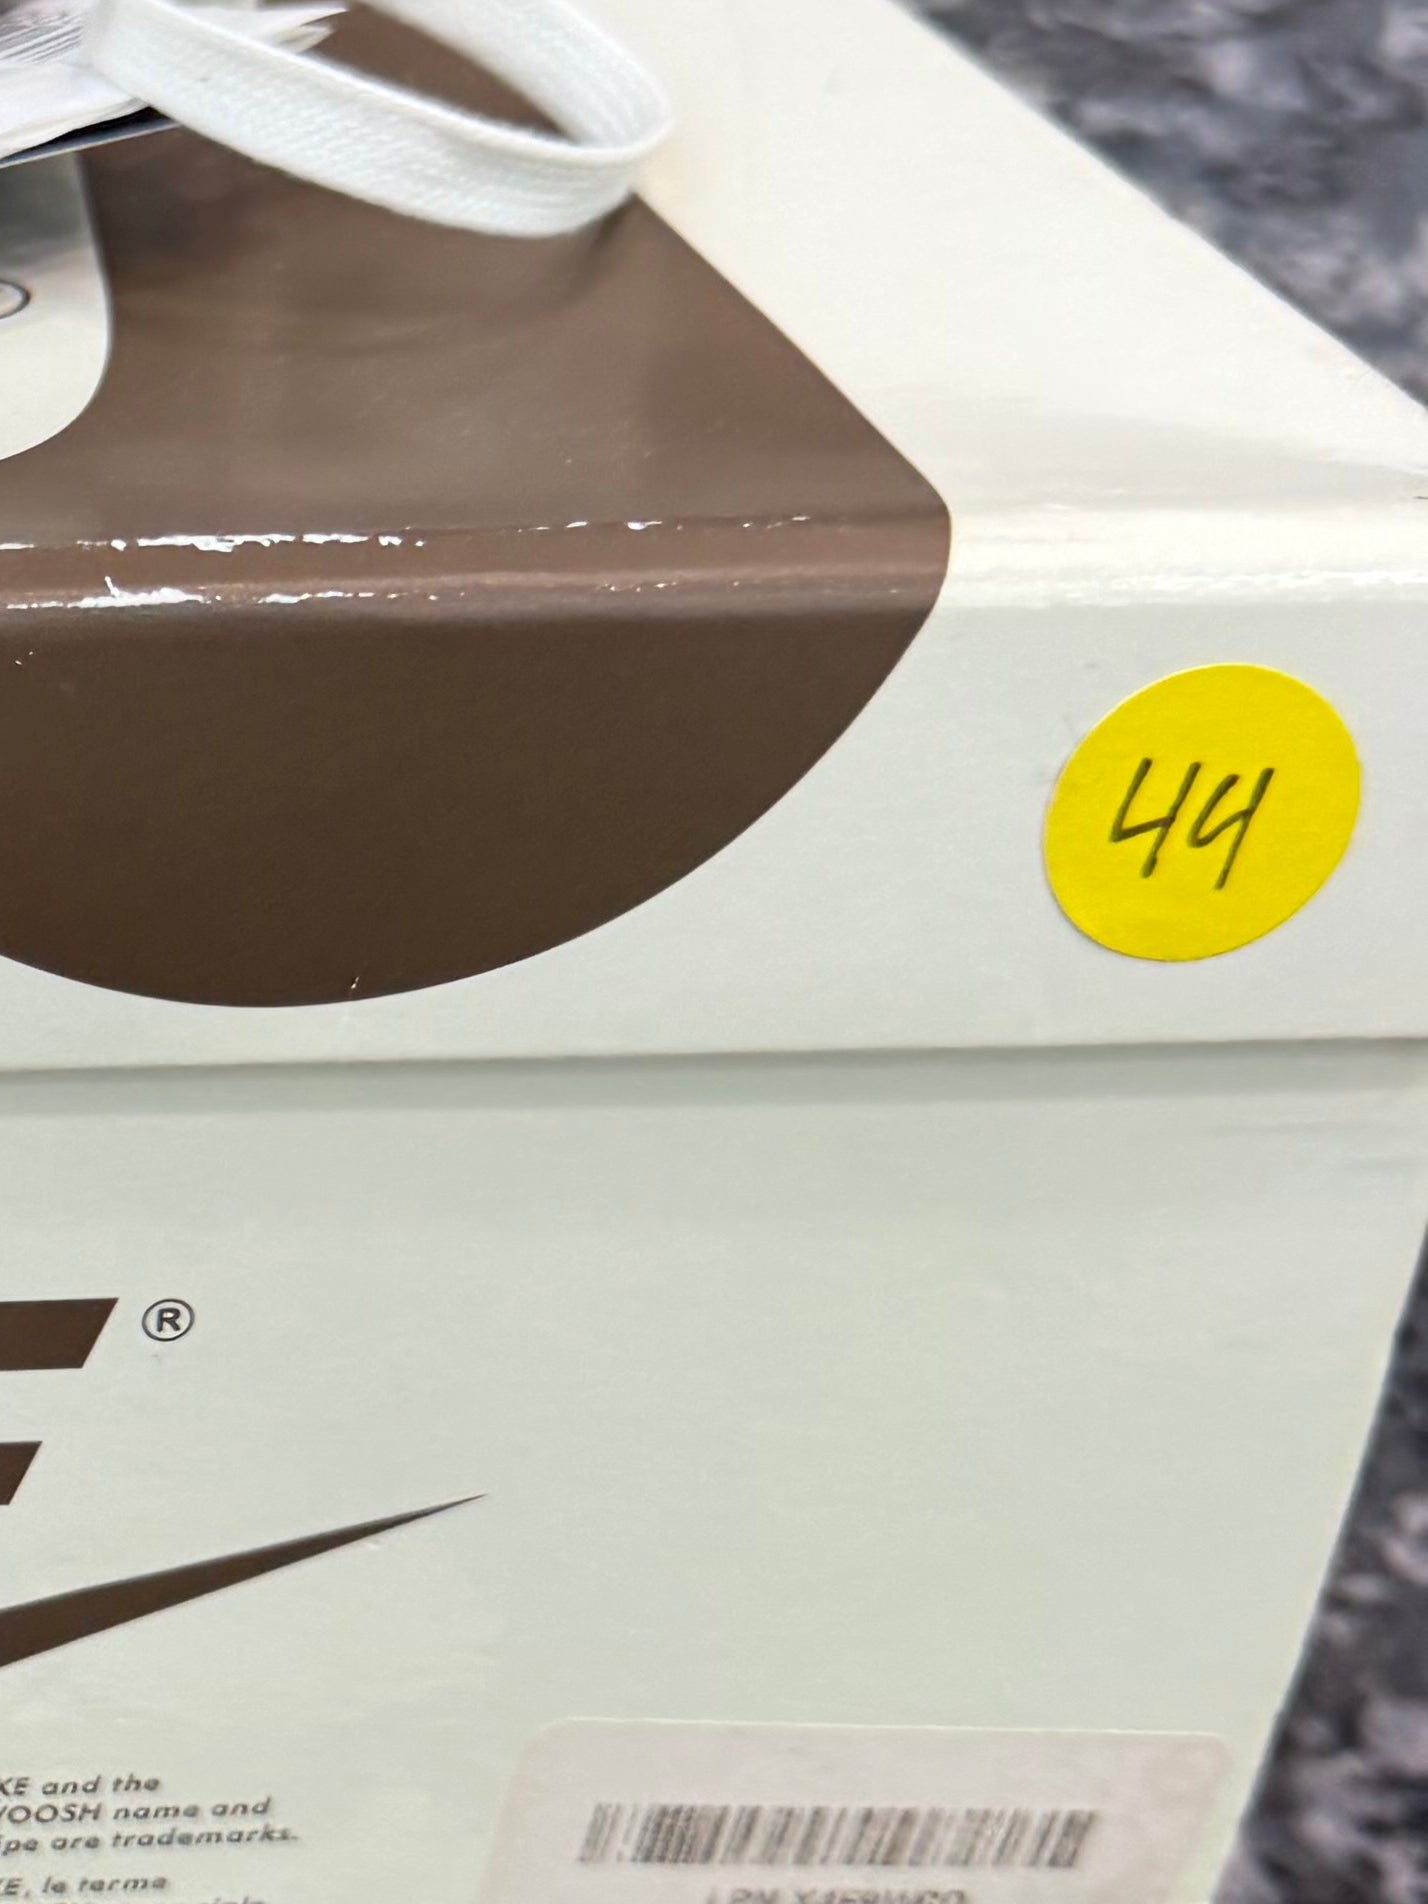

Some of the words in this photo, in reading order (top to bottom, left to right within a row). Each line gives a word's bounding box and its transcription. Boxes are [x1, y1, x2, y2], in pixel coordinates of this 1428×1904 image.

[1109, 757, 1275, 890] 44
[42, 1773, 102, 1796] and
[112, 1772, 161, 1793] the
[112, 1804, 200, 1821] name
[211, 1793, 272, 1817] and
[50, 1836, 101, 1851] are
[111, 1822, 300, 1848] trademarks.
[41, 1875, 67, 1894] le
[78, 1875, 168, 1893] terme
